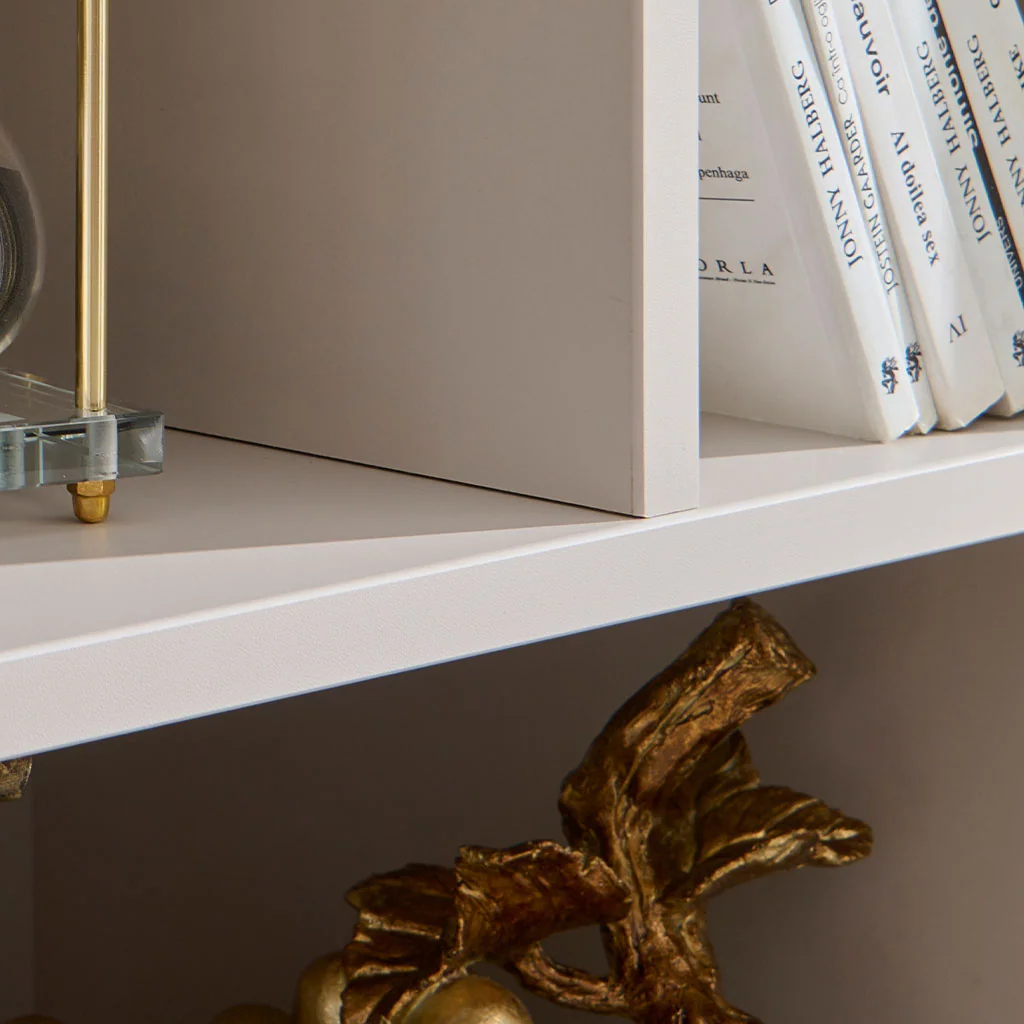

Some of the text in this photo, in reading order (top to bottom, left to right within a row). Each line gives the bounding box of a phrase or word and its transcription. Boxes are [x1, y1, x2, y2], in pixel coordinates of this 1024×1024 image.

[791, 60, 835, 178] HALBERG
[837, 77, 849, 105] Ca
[916, 40, 961, 156] HALBERG
[967, 34, 1011, 147] HALBERG
[843, 115, 875, 210] GAARDER
[890, 131, 909, 156] Al
[900, 159, 926, 226] doilea
[921, 230, 940, 266] sex
[955, 164, 992, 245] JONNY
[826, 184, 864, 269] JONNY
[868, 212, 900, 295] JOSTEIN
